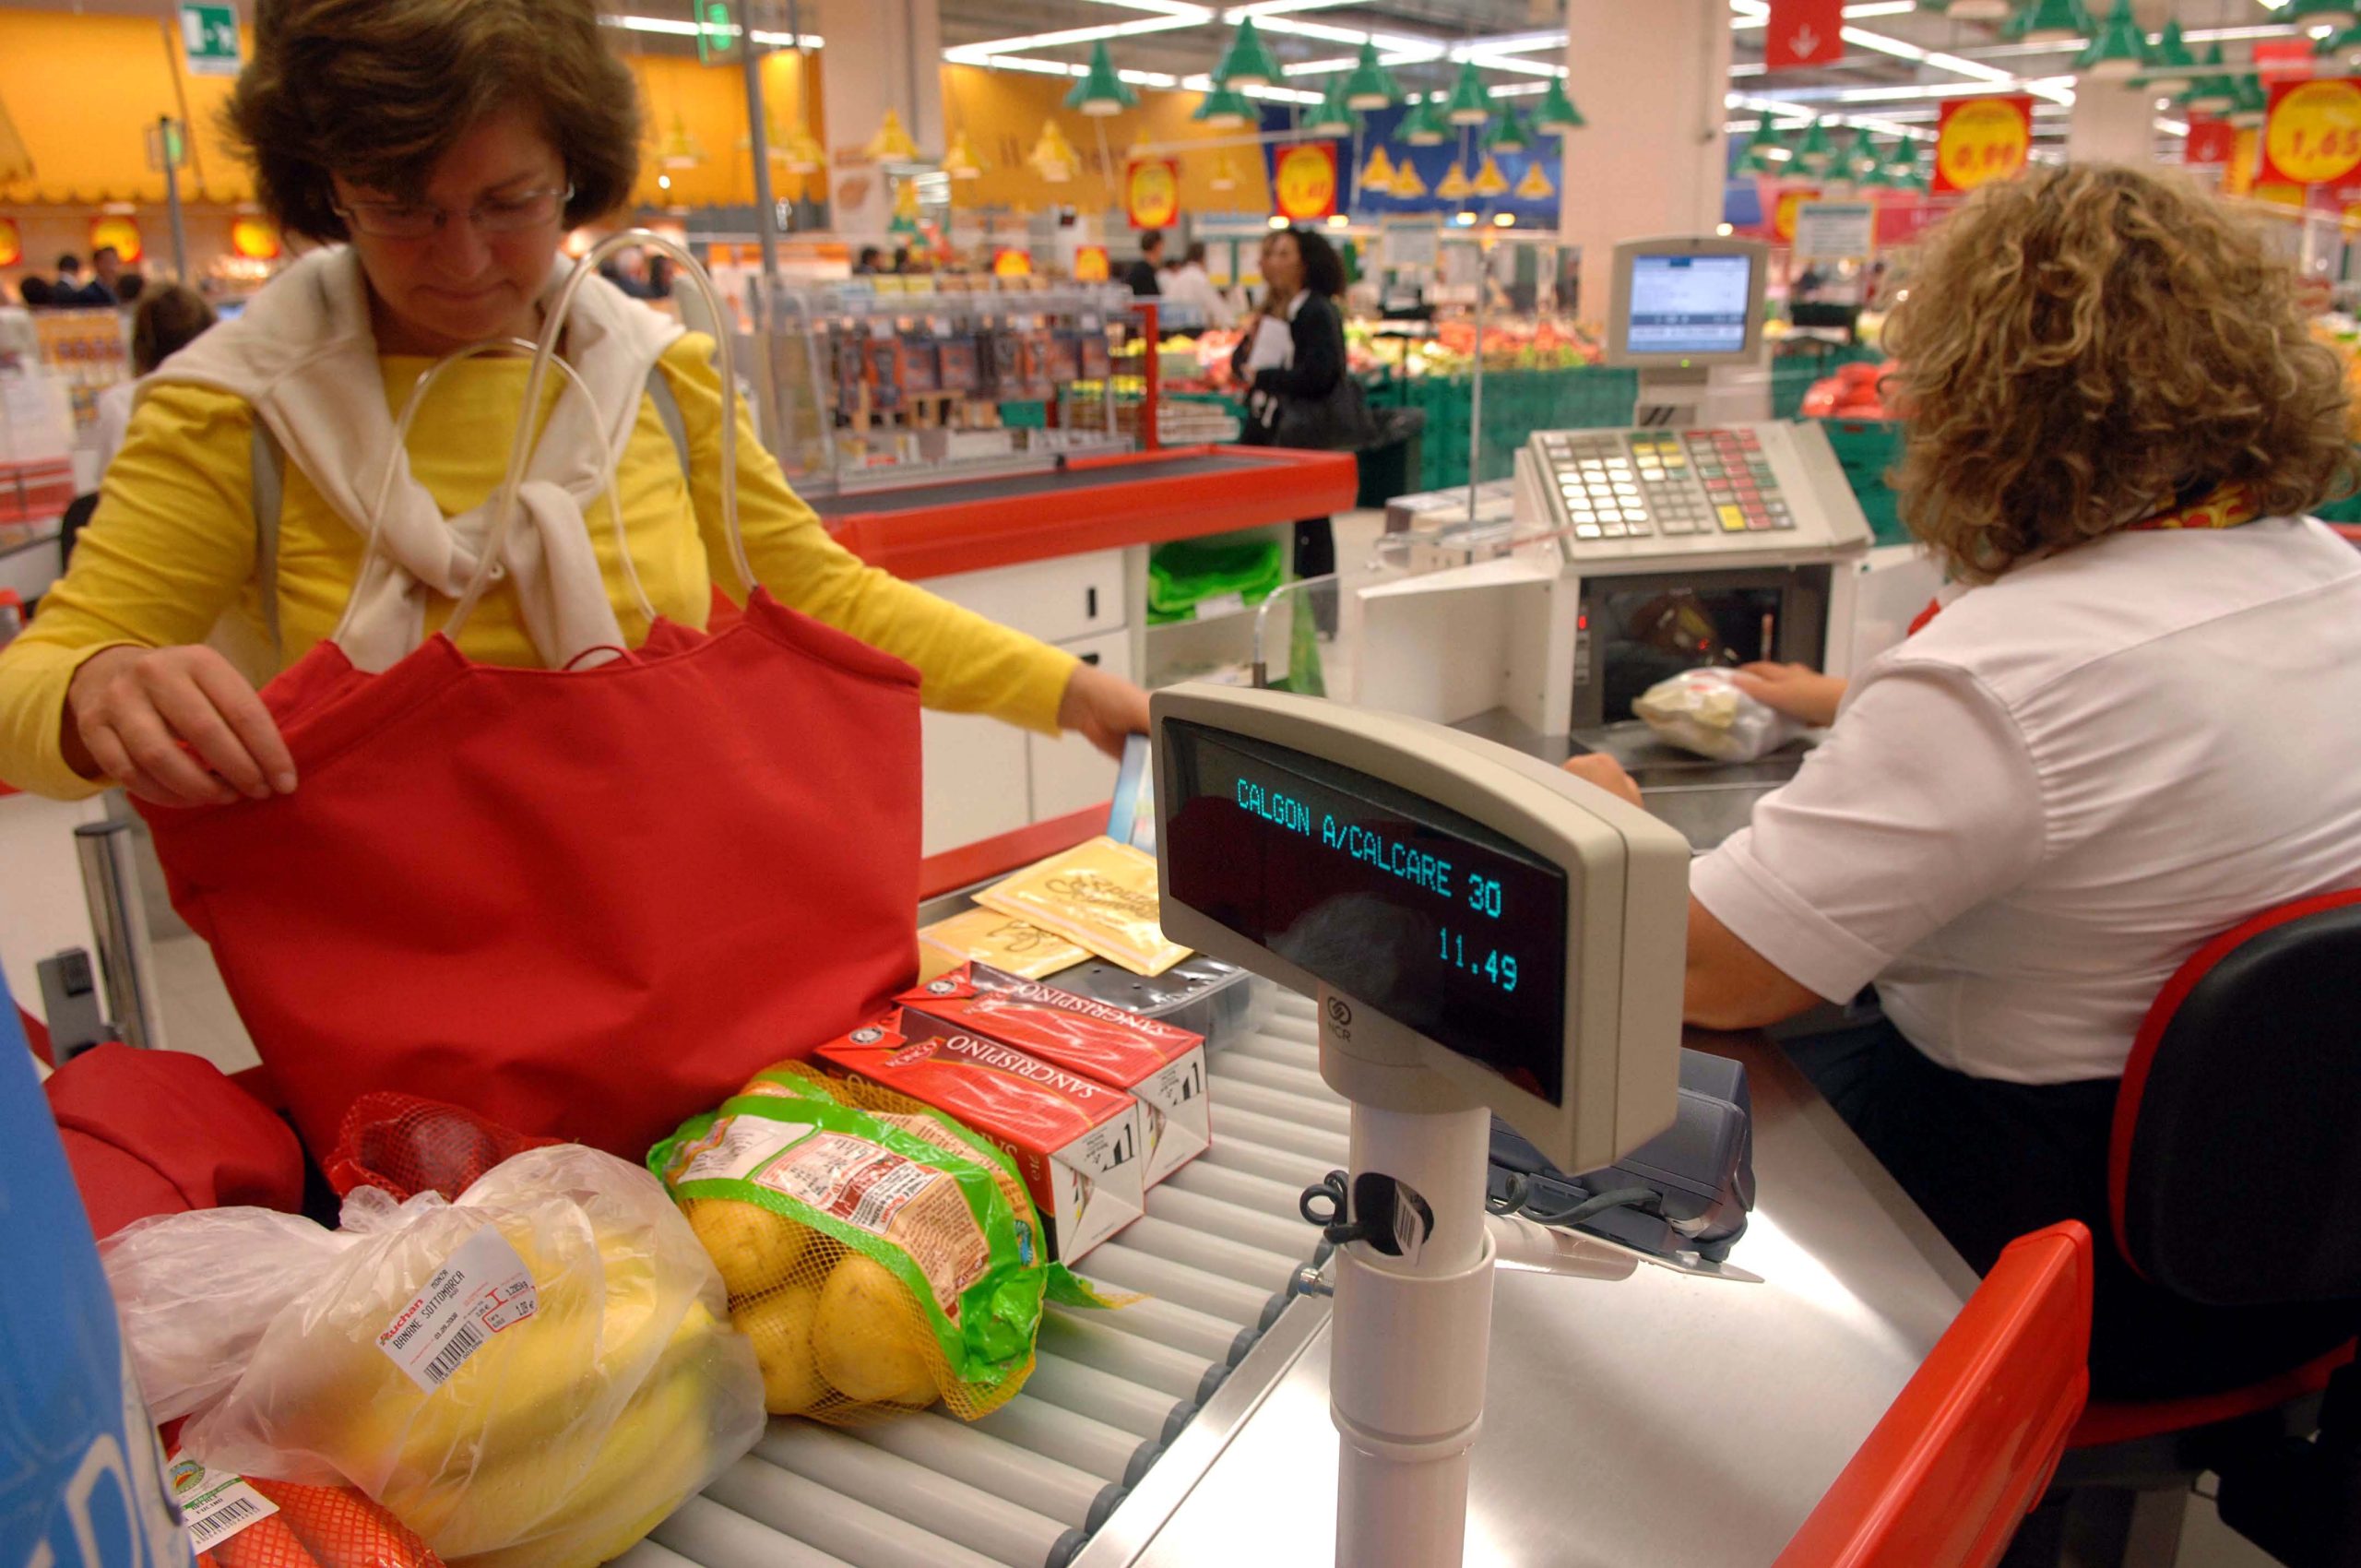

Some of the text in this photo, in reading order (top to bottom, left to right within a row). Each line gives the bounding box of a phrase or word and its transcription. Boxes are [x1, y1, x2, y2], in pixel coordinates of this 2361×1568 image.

[1238, 778, 1501, 919] CALGON A/CALCARE 30
[1441, 927, 1517, 992] 11.49
[1017, 981, 1169, 1039] SANCRISPINO
[945, 1034, 1101, 1099] SANCRISPINO
[378, 1297, 424, 1346] Auchan
[393, 1318, 422, 1349] BANANE
[421, 1271, 466, 1319] SOTTOMARCA
